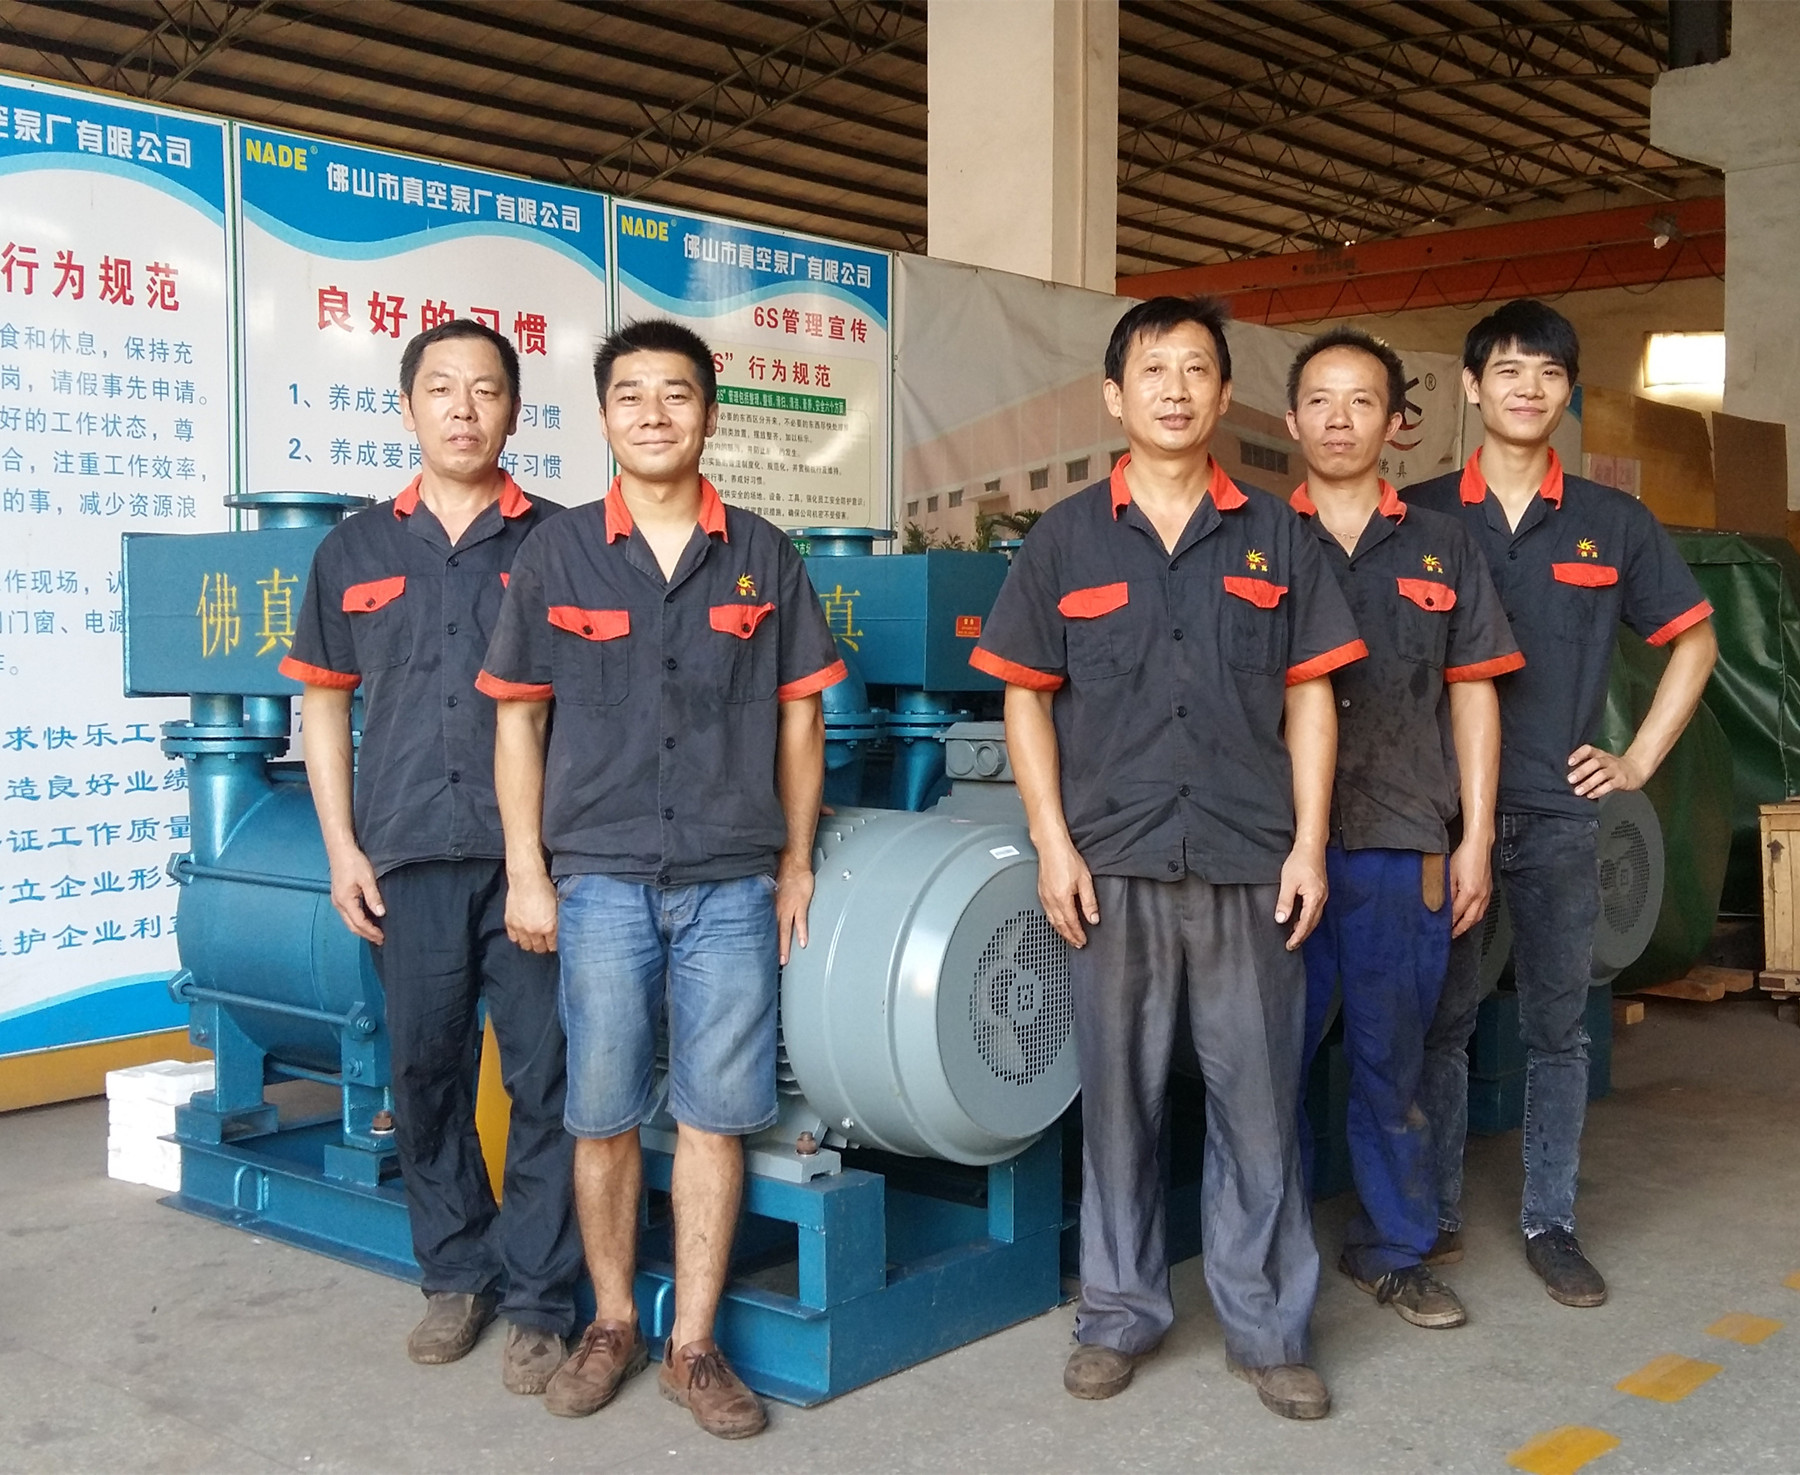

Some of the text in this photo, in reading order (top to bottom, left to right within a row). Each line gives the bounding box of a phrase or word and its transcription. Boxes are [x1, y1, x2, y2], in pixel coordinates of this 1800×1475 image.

[246, 139, 307, 171] NADE
[327, 162, 581, 233] 佛山市真空泵厂有限公司
[621, 215, 669, 242] NADE
[1, 242, 179, 311] 行为规范
[684, 232, 871, 288] 佛山市真空泵厂有限公司
[0, 322, 193, 365] 食和休息，保持充
[754, 306, 868, 343] 6S管理宣传
[1, 364, 207, 406] 岗，请假事先申请。
[749, 355, 830, 388] 行为规范
[0, 405, 194, 442] 好的工作状态，尊
[522, 403, 561, 430] 习惯
[3, 488, 197, 519] 的事，减少资源浪
[0, 609, 125, 634] 门窗、电源
[196, 567, 299, 659] 佛真
[819, 584, 864, 652] 真
[0, 815, 191, 853] 证工作质量
[0, 866, 180, 904] 立企业形
[0, 915, 178, 957] 护企业利
